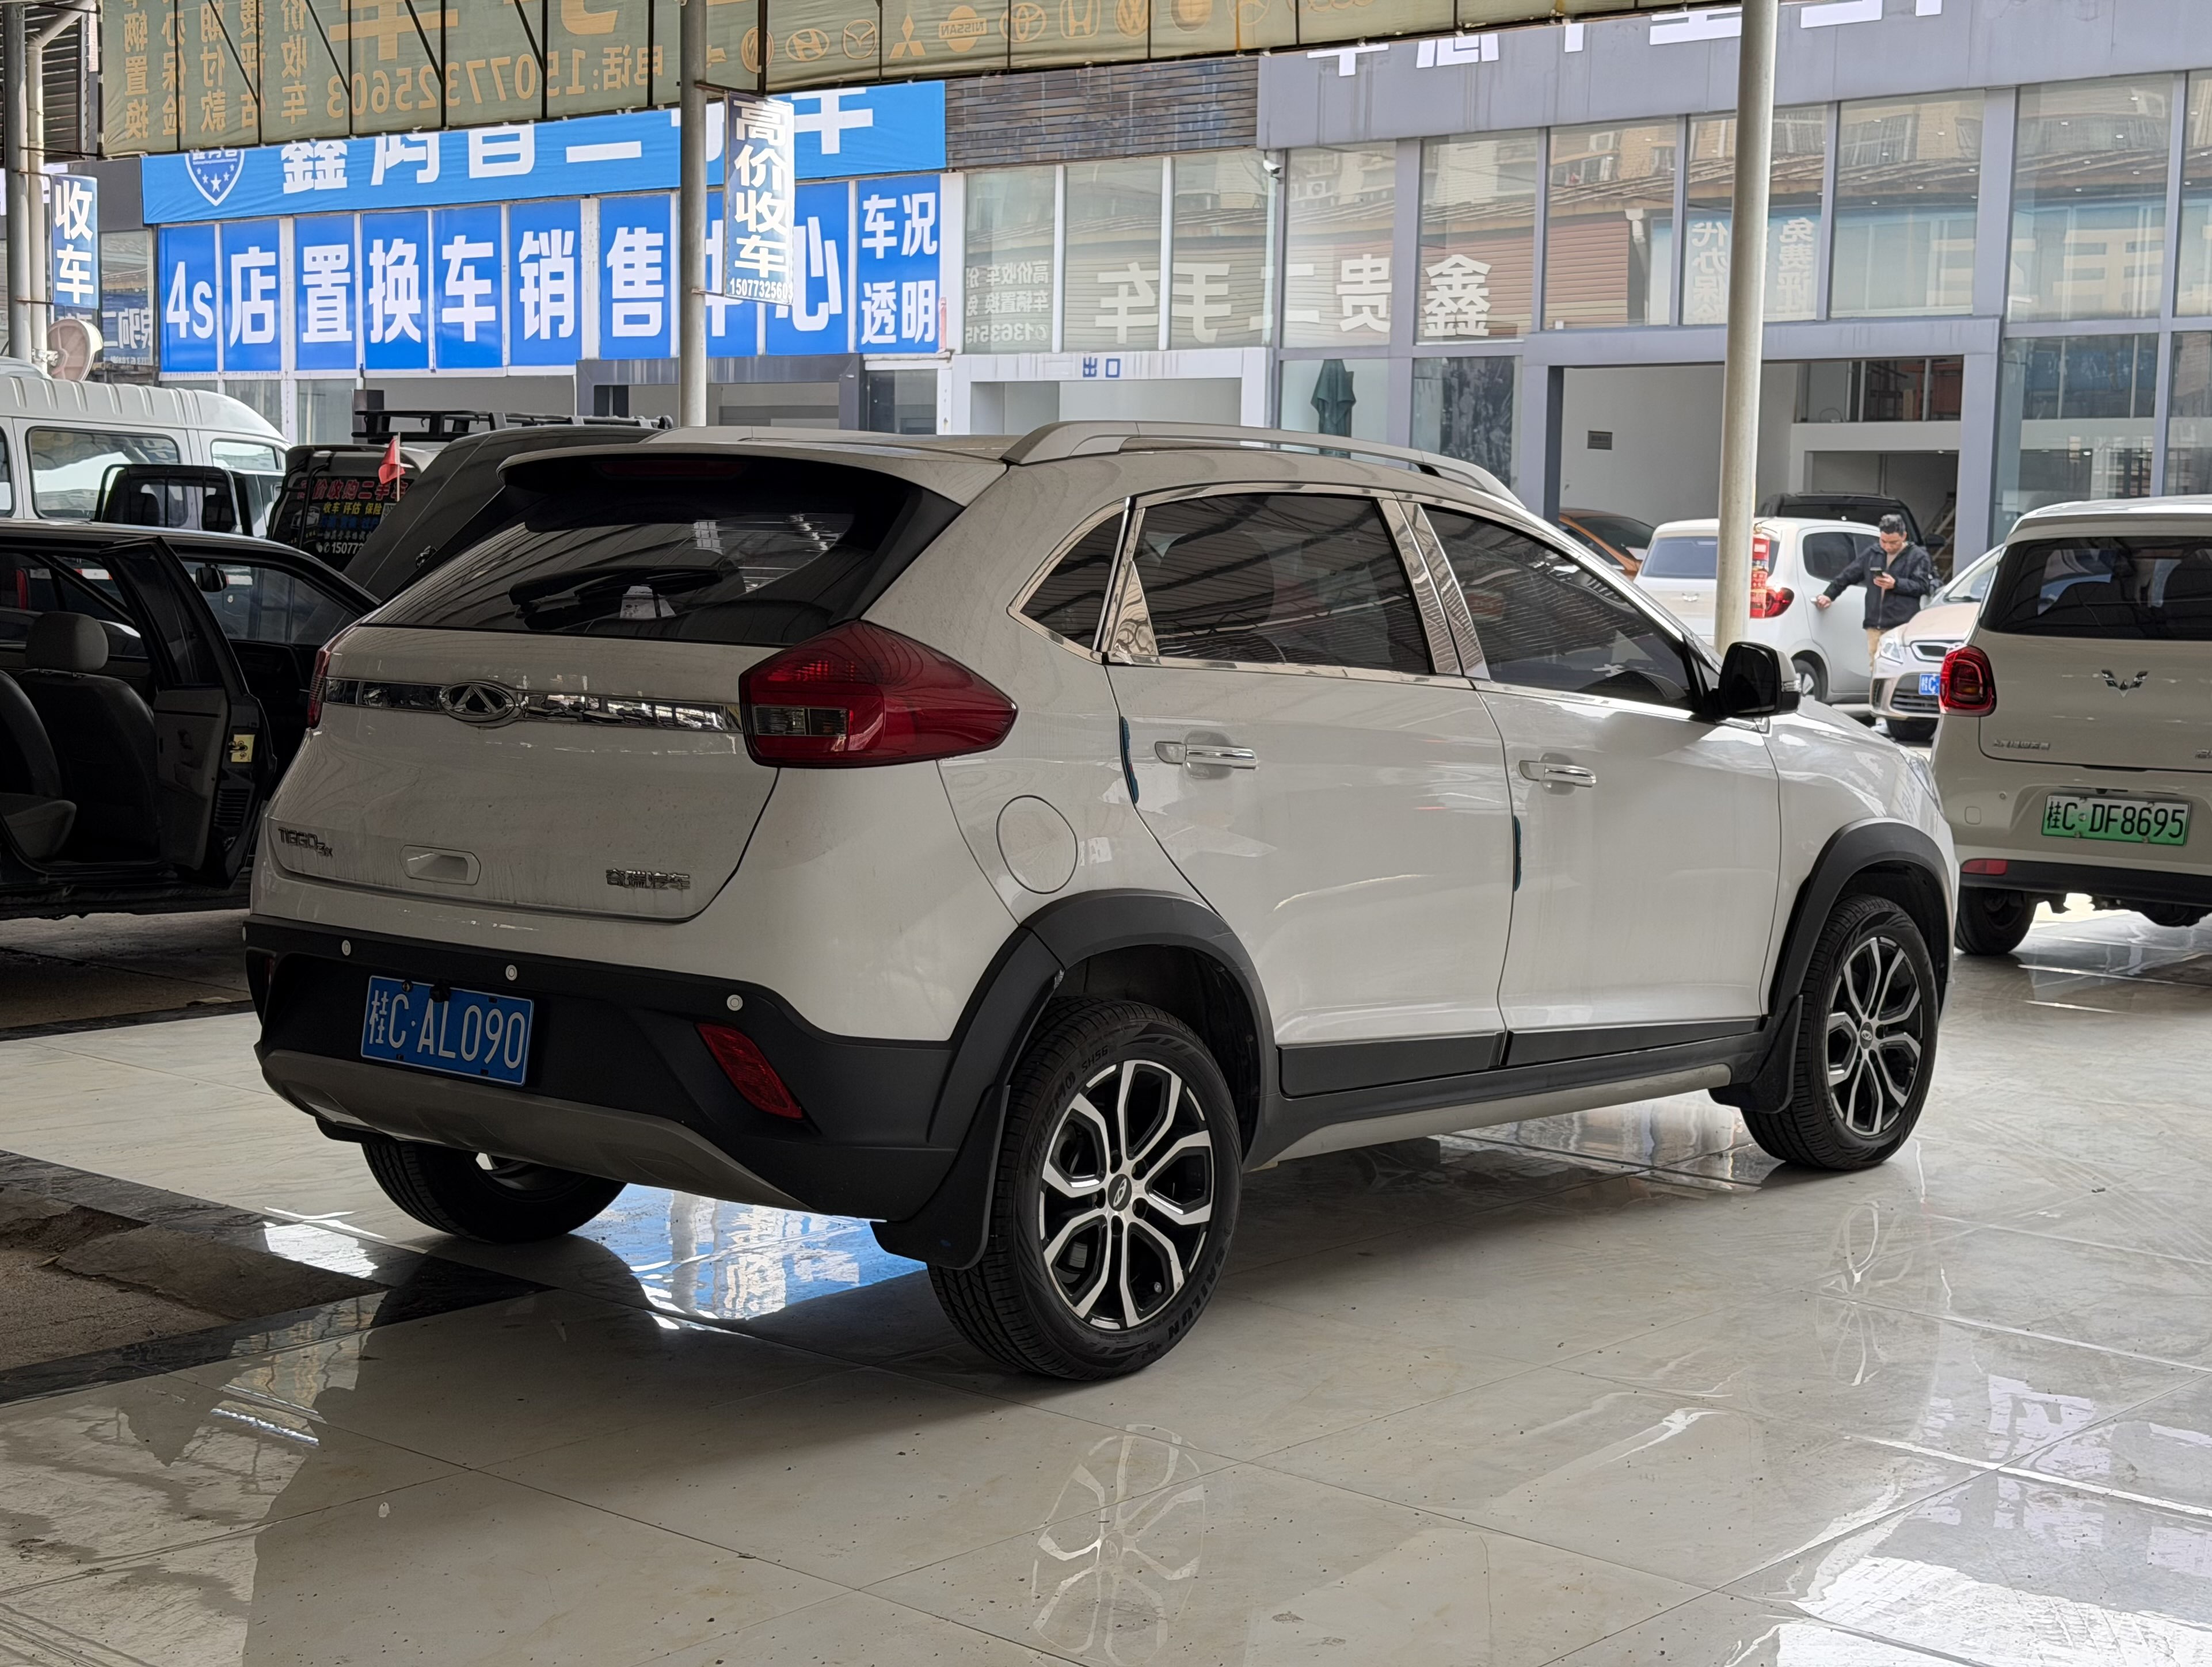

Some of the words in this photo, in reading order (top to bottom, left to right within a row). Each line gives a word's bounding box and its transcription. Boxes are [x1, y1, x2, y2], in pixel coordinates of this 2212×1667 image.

[733, 100, 787, 278] 高价收车
[55, 180, 94, 304] 收车
[863, 192, 938, 259] 车况
[862, 280, 936, 345] 透明
[1083, 356, 1121, 378] 出口
[323, 502, 341, 515] 收车
[342, 502, 361, 515] 评估
[364, 503, 383, 515] 保险
